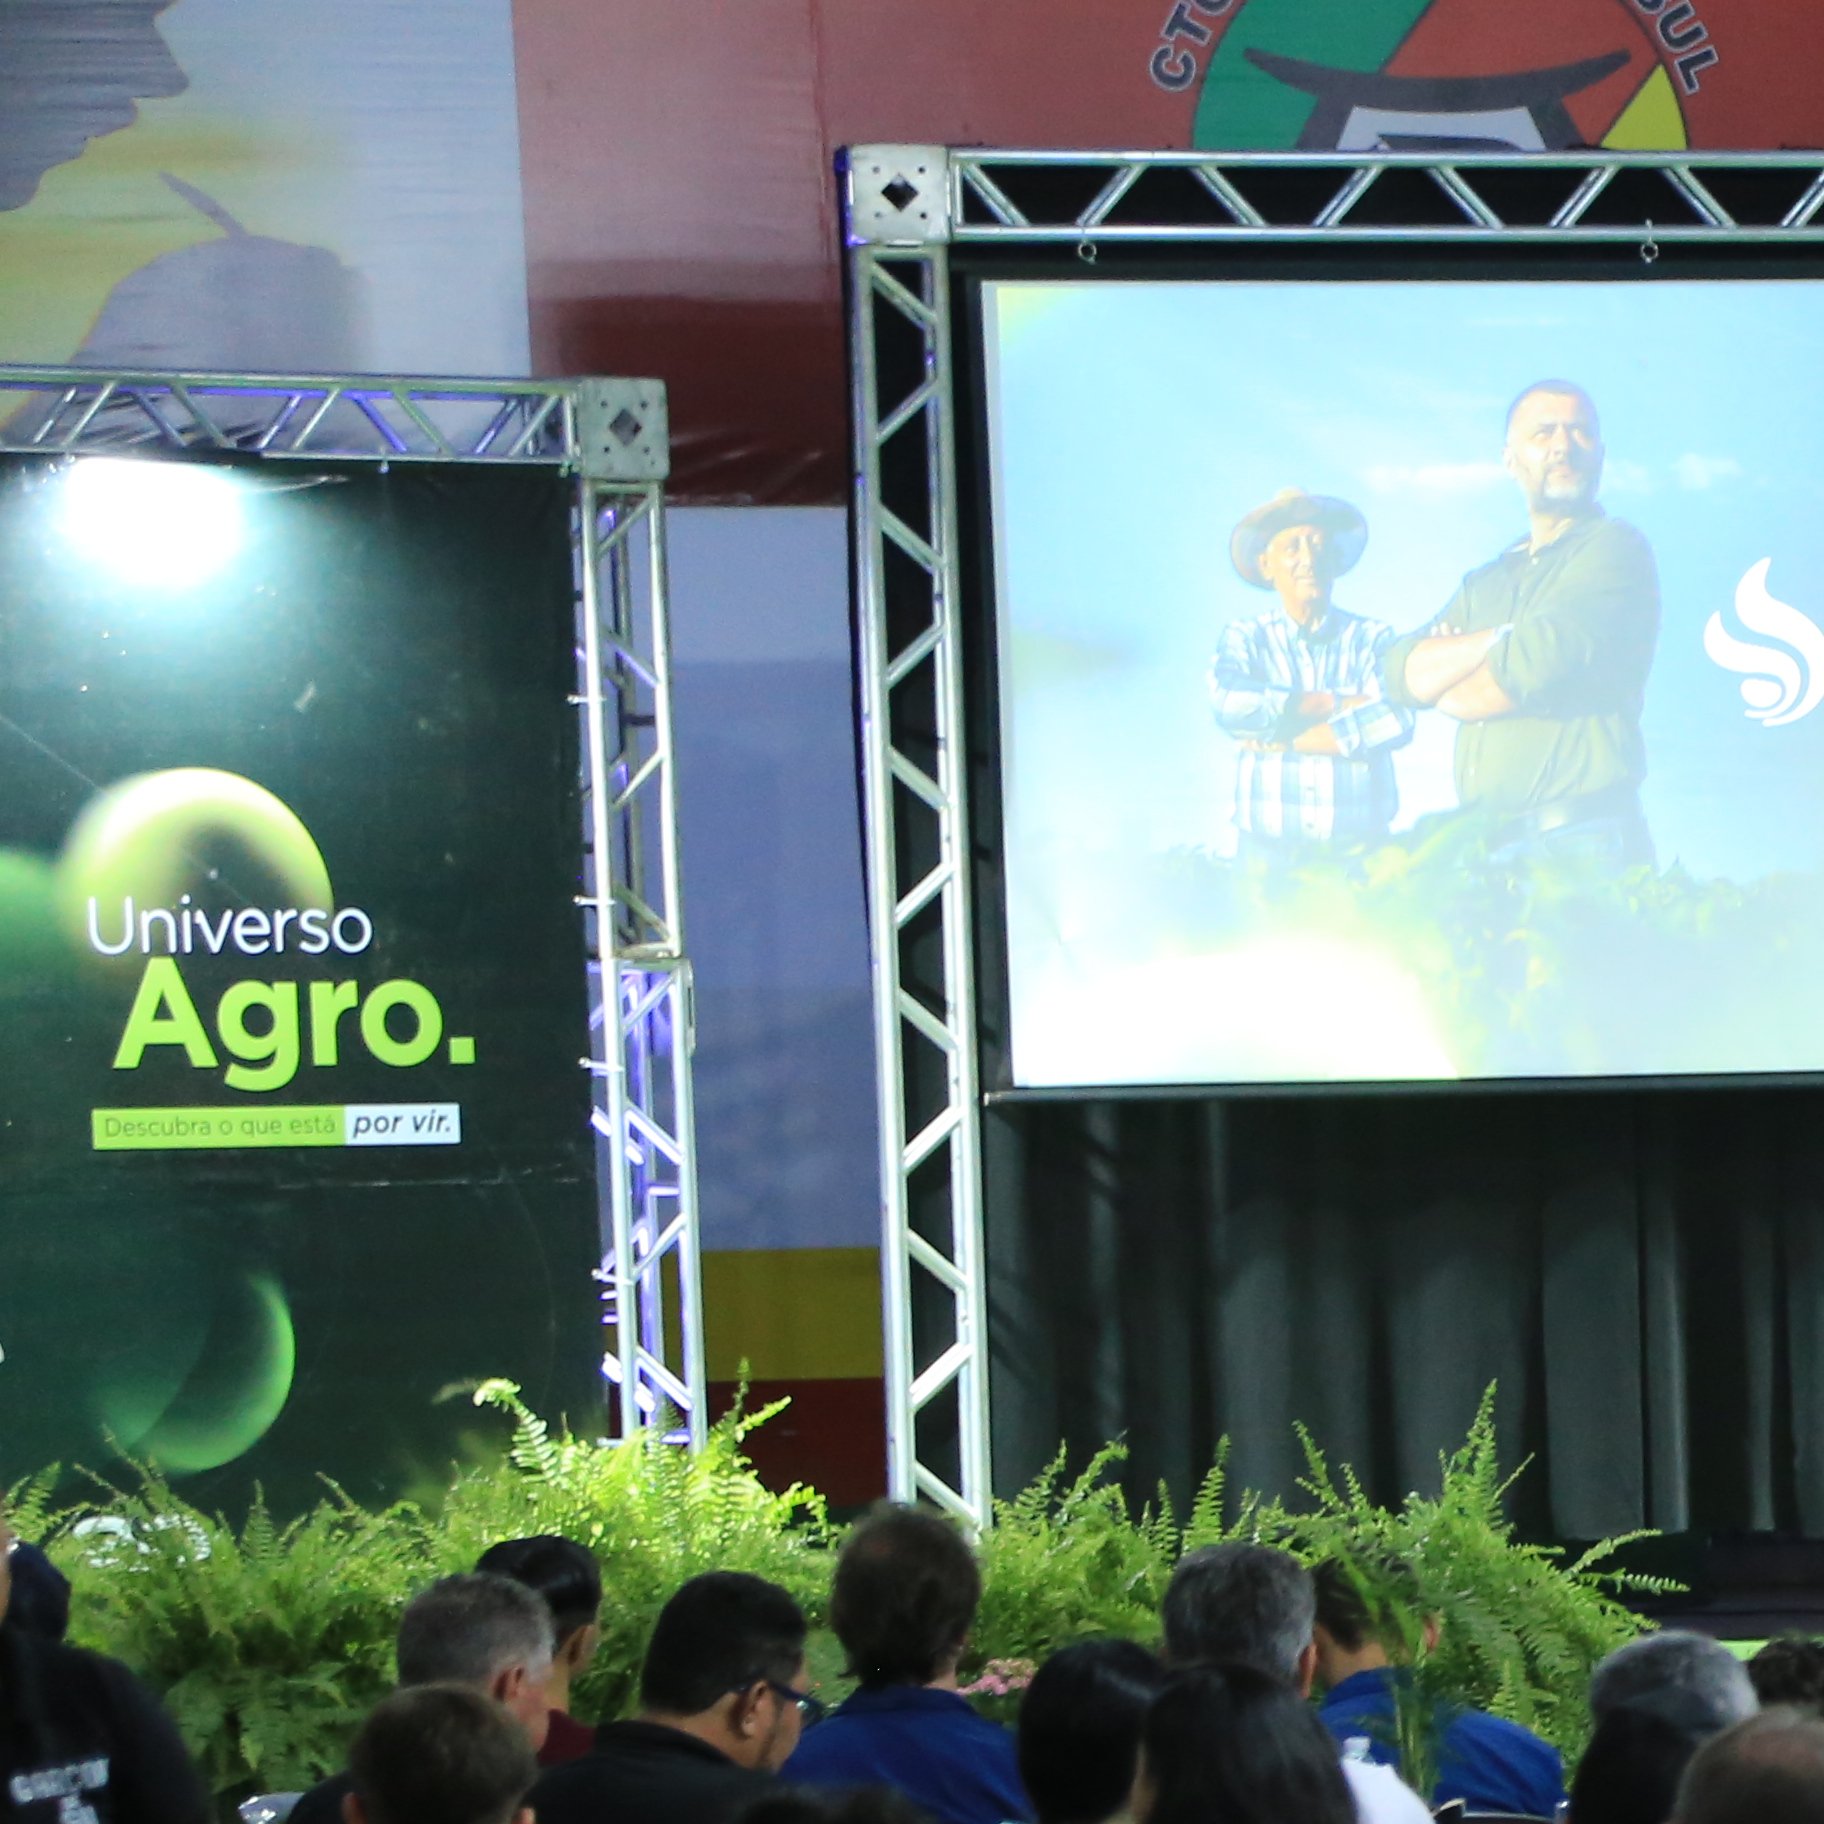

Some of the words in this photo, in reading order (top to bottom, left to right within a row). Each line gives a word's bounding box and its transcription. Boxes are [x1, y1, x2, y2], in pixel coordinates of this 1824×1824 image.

[1149, 0, 1236, 92] CT
[1635, 0, 1719, 95] UL
[86, 893, 373, 955] Universo
[112, 956, 477, 1092] Agro.
[104, 1117, 212, 1140] Descubra
[219, 1119, 234, 1135] o
[240, 1118, 281, 1142] que
[289, 1111, 337, 1134] está
[352, 1113, 404, 1140] por
[411, 1107, 452, 1134] vir.
